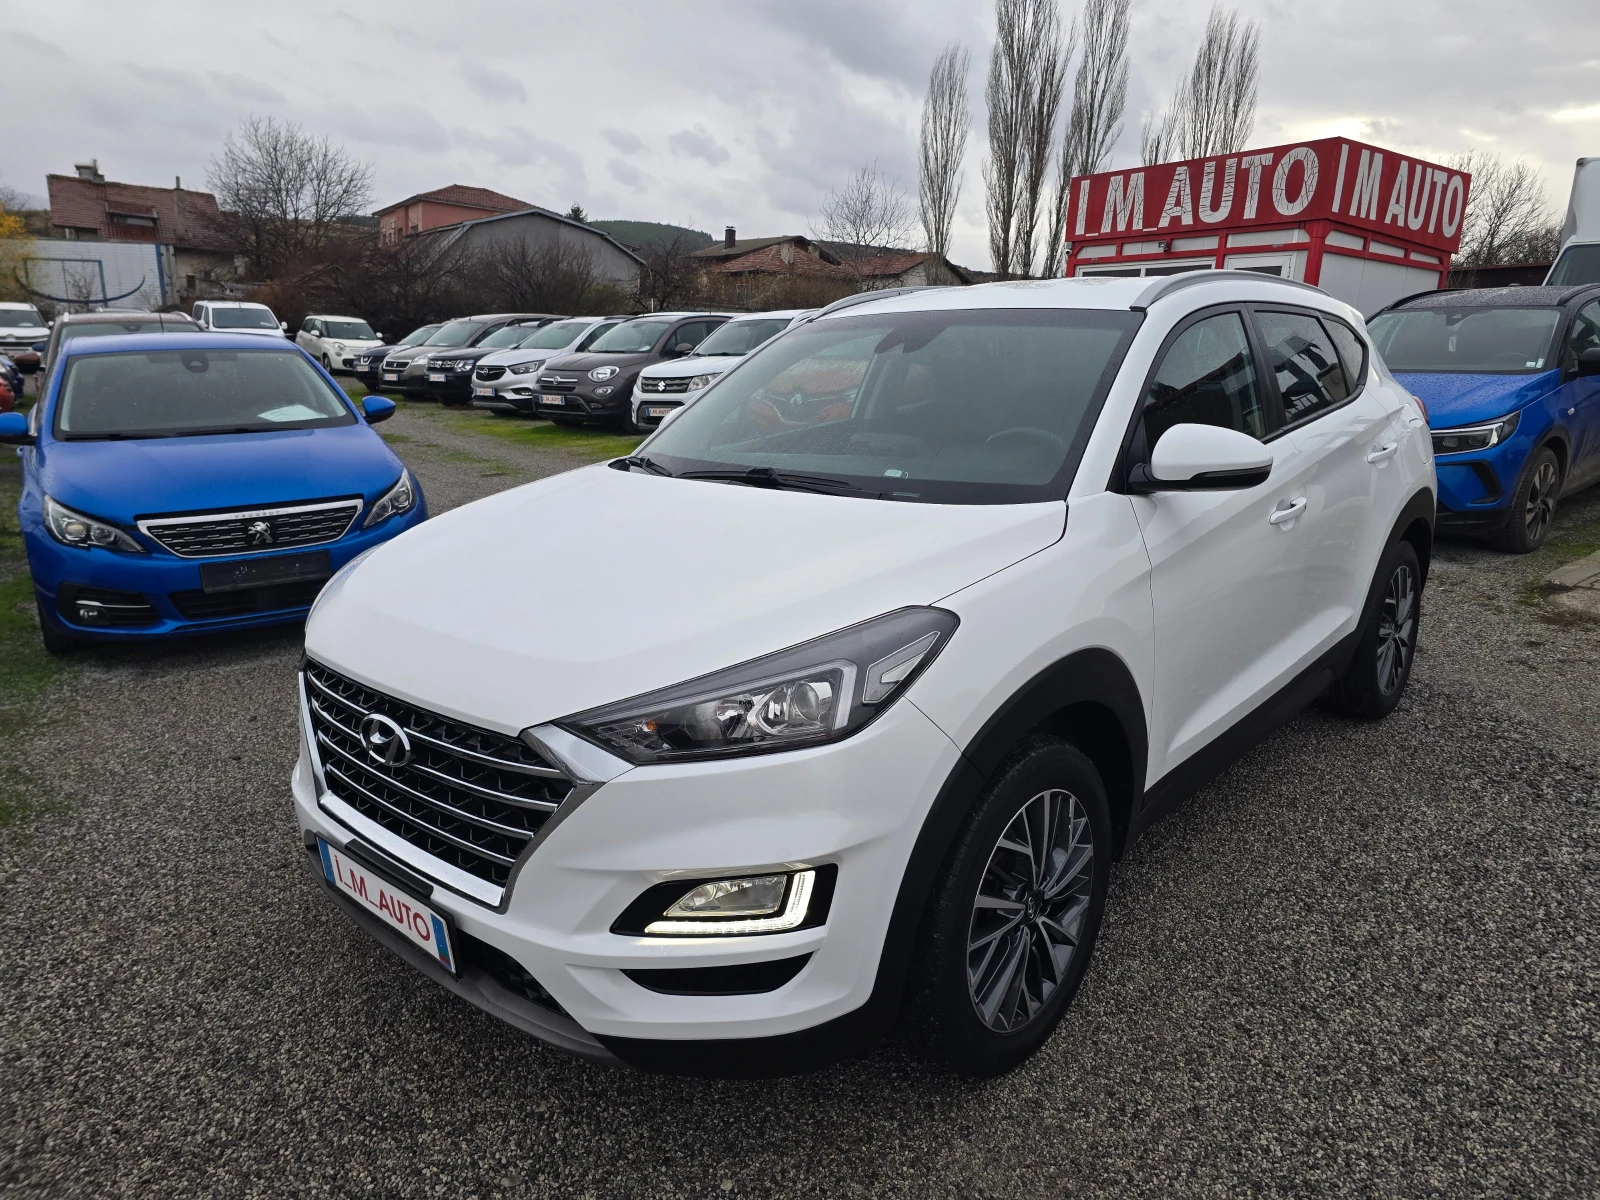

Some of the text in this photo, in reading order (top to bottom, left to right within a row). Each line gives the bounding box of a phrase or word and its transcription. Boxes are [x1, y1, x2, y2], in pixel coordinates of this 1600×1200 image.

[1331, 143, 1464, 239] I M AUTO
